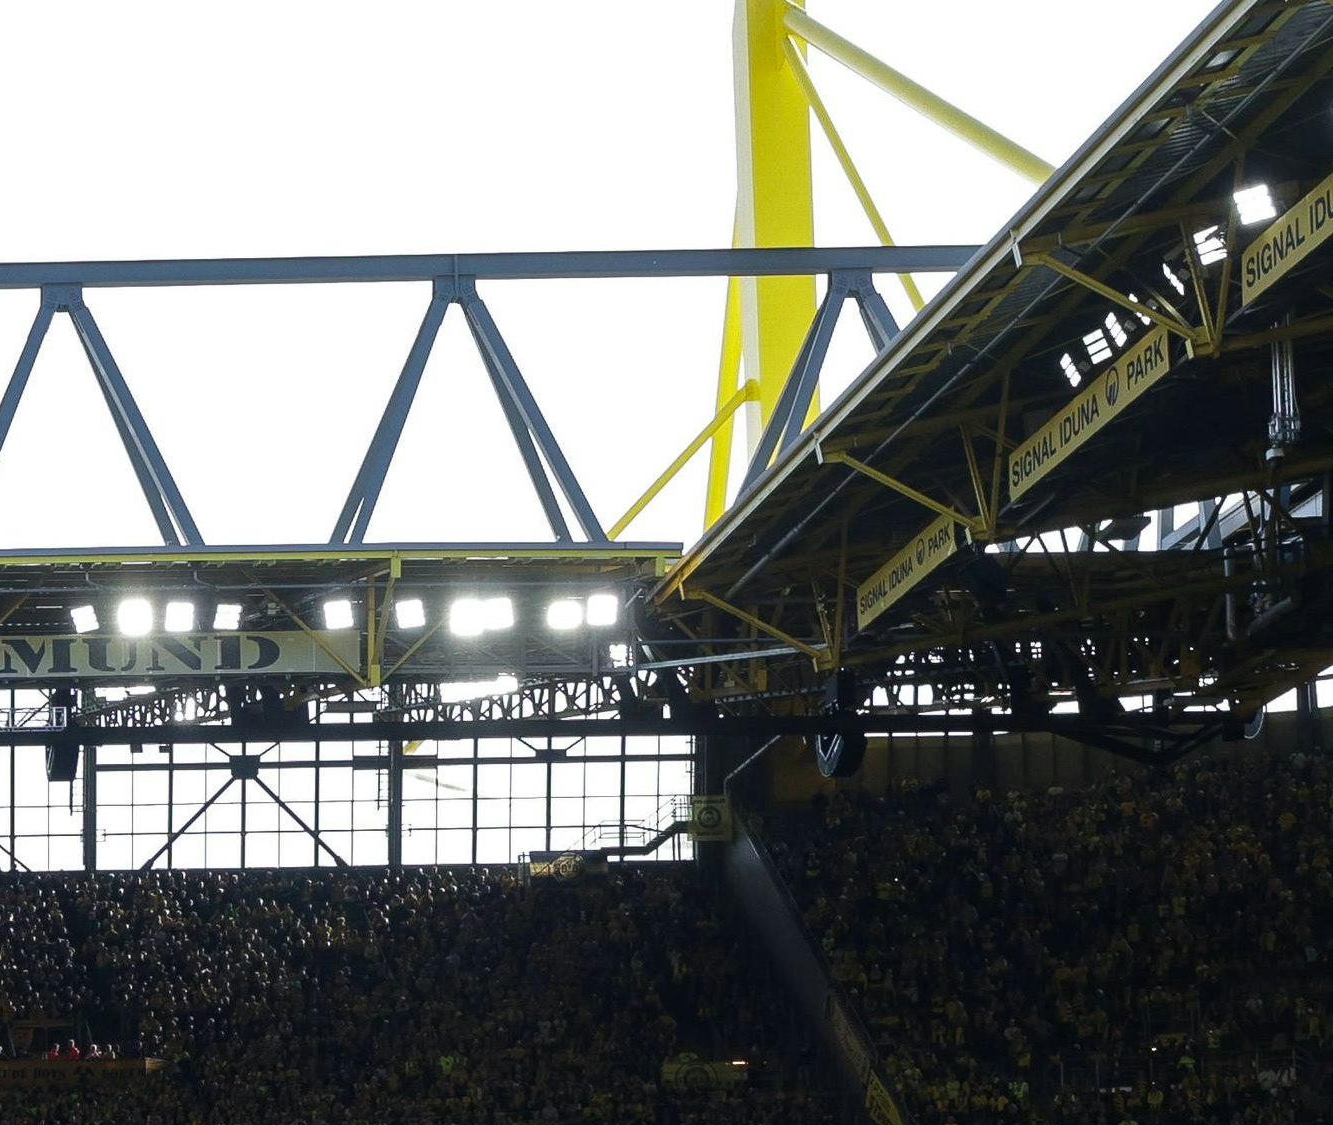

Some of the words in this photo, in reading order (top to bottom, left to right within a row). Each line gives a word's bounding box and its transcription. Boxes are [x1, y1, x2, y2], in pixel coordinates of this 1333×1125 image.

[1245, 221, 1305, 288] SIGNAL
[1010, 430, 1059, 489] SIGNAL
[1058, 393, 1100, 458] IDUNA
[1126, 340, 1165, 387] PARK
[859, 588, 887, 616] SIGNAL
[886, 560, 913, 596] IDUNA
[928, 524, 951, 558] PARK
